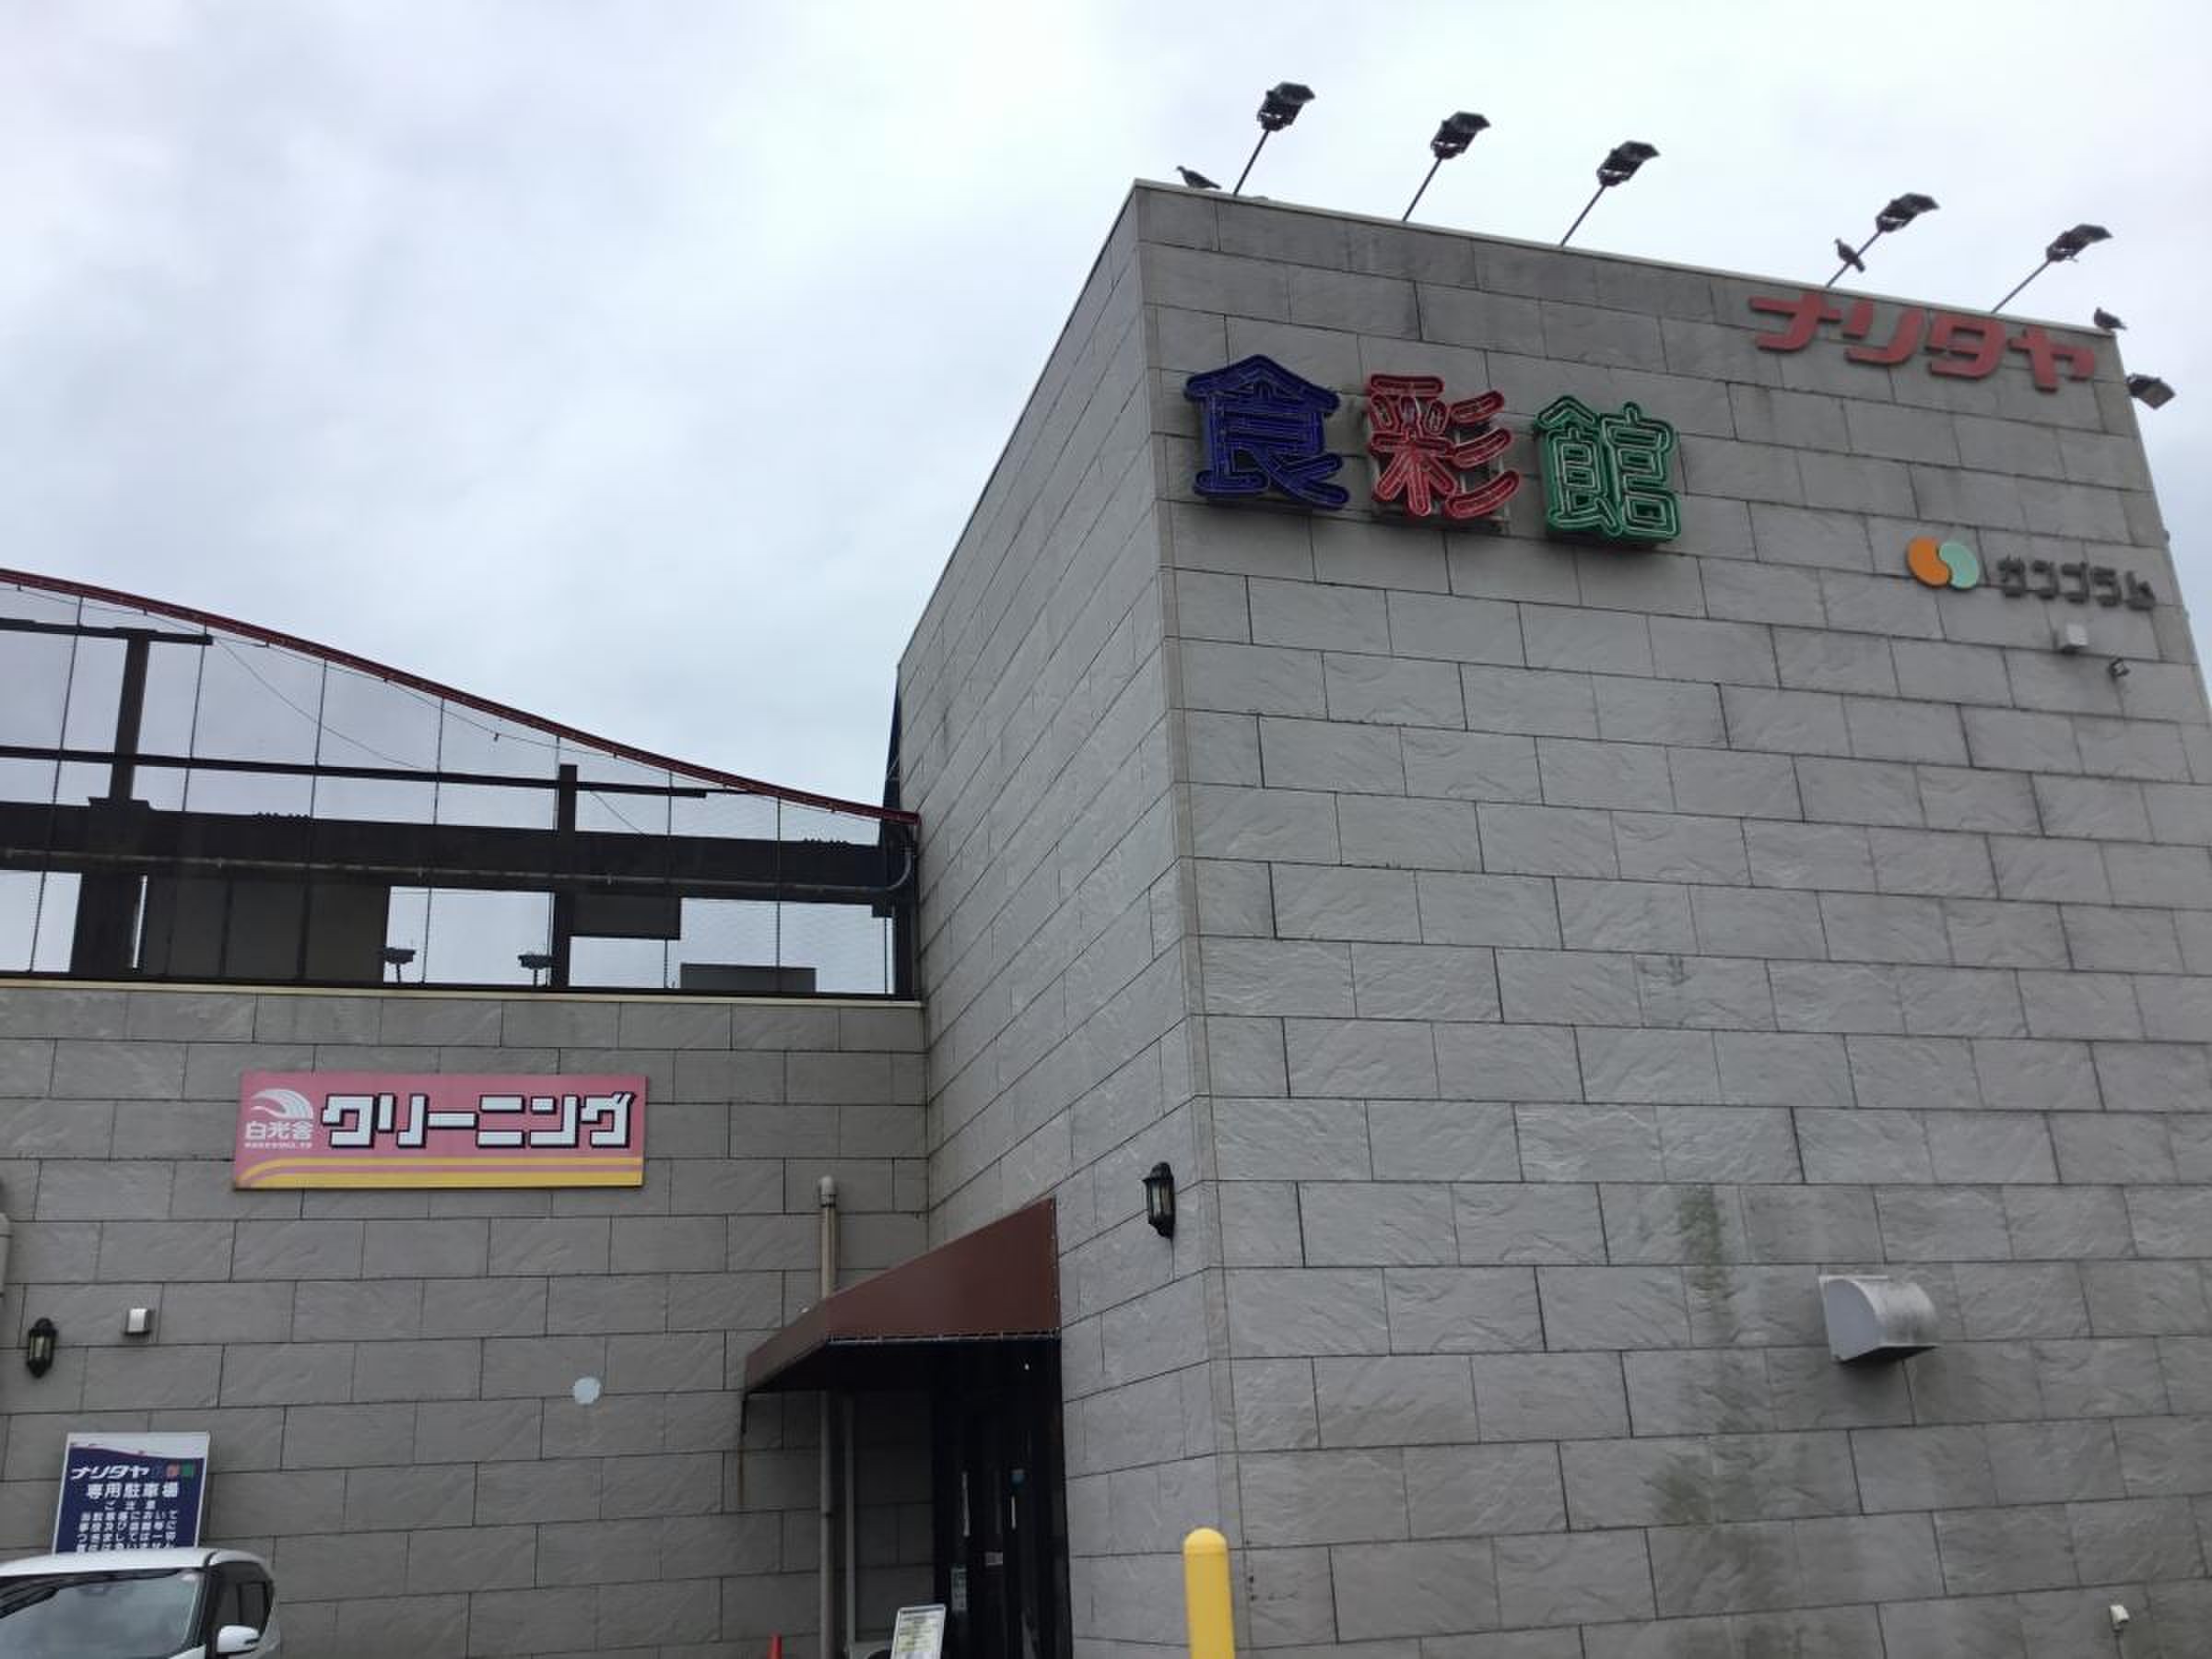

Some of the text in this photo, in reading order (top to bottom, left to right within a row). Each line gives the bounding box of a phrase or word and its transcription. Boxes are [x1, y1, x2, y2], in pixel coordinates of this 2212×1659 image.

[1748, 290, 2094, 393] ナリタヤ
[1184, 355, 1681, 540] 食彩館
[322, 1091, 634, 1147] クリーニング
[70, 1465, 149, 1479] ナリタヤ
